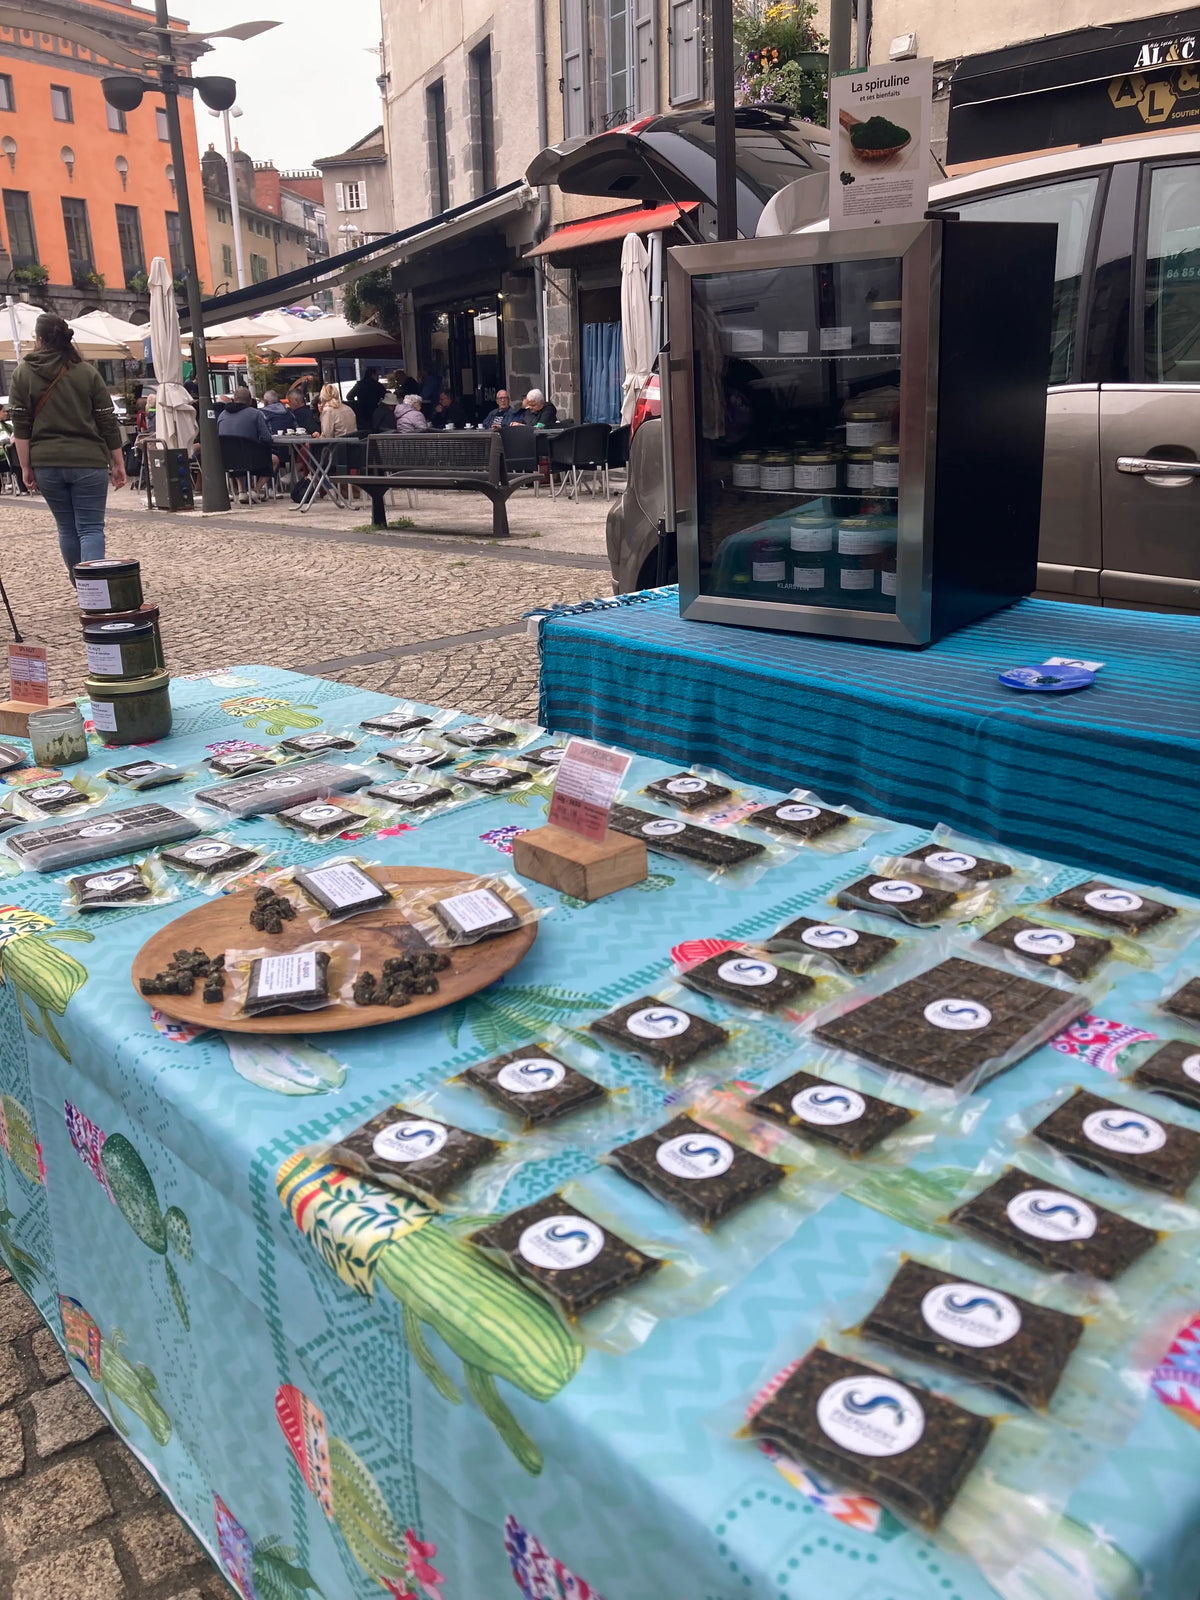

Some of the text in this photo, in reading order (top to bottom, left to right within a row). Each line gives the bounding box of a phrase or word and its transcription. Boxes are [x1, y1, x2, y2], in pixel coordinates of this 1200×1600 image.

[851, 75, 910, 93] La spiruline
[876, 90, 901, 99] bienfaits
[1171, 109, 1200, 119] SOUTIEN
[1166, 269, 1179, 279] 86
[1181, 267, 1195, 278] 85
